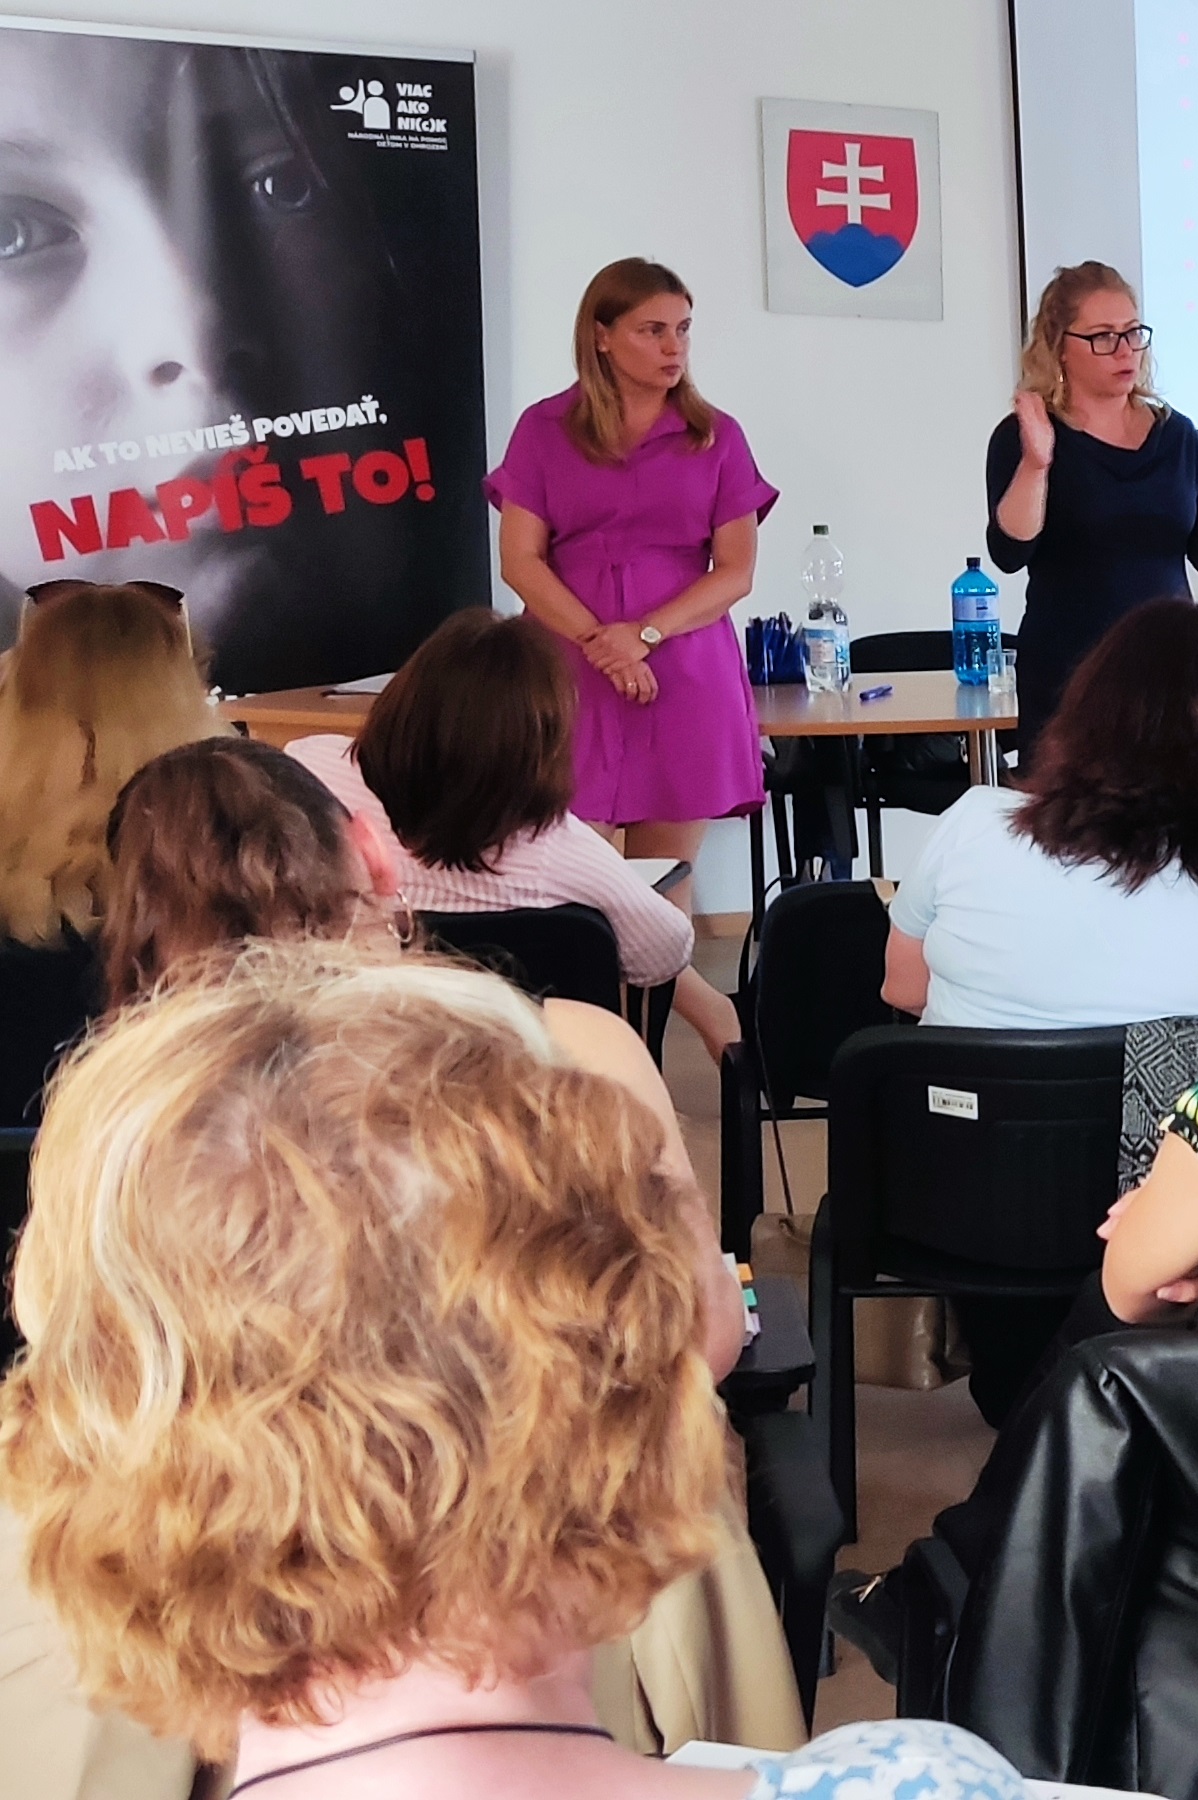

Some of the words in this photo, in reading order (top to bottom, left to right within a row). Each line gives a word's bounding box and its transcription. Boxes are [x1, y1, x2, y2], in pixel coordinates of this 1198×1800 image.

[396, 83, 432, 97] VIAC
[397, 100, 429, 114] AKO
[53, 444, 95, 473] AK
[98, 441, 141, 465] TO
[146, 413, 250, 458] NEVIEŠ
[252, 394, 388, 443] POVEDAŤ,
[29, 444, 292, 562] NAPÍŠ
[299, 436, 436, 515] TO!
